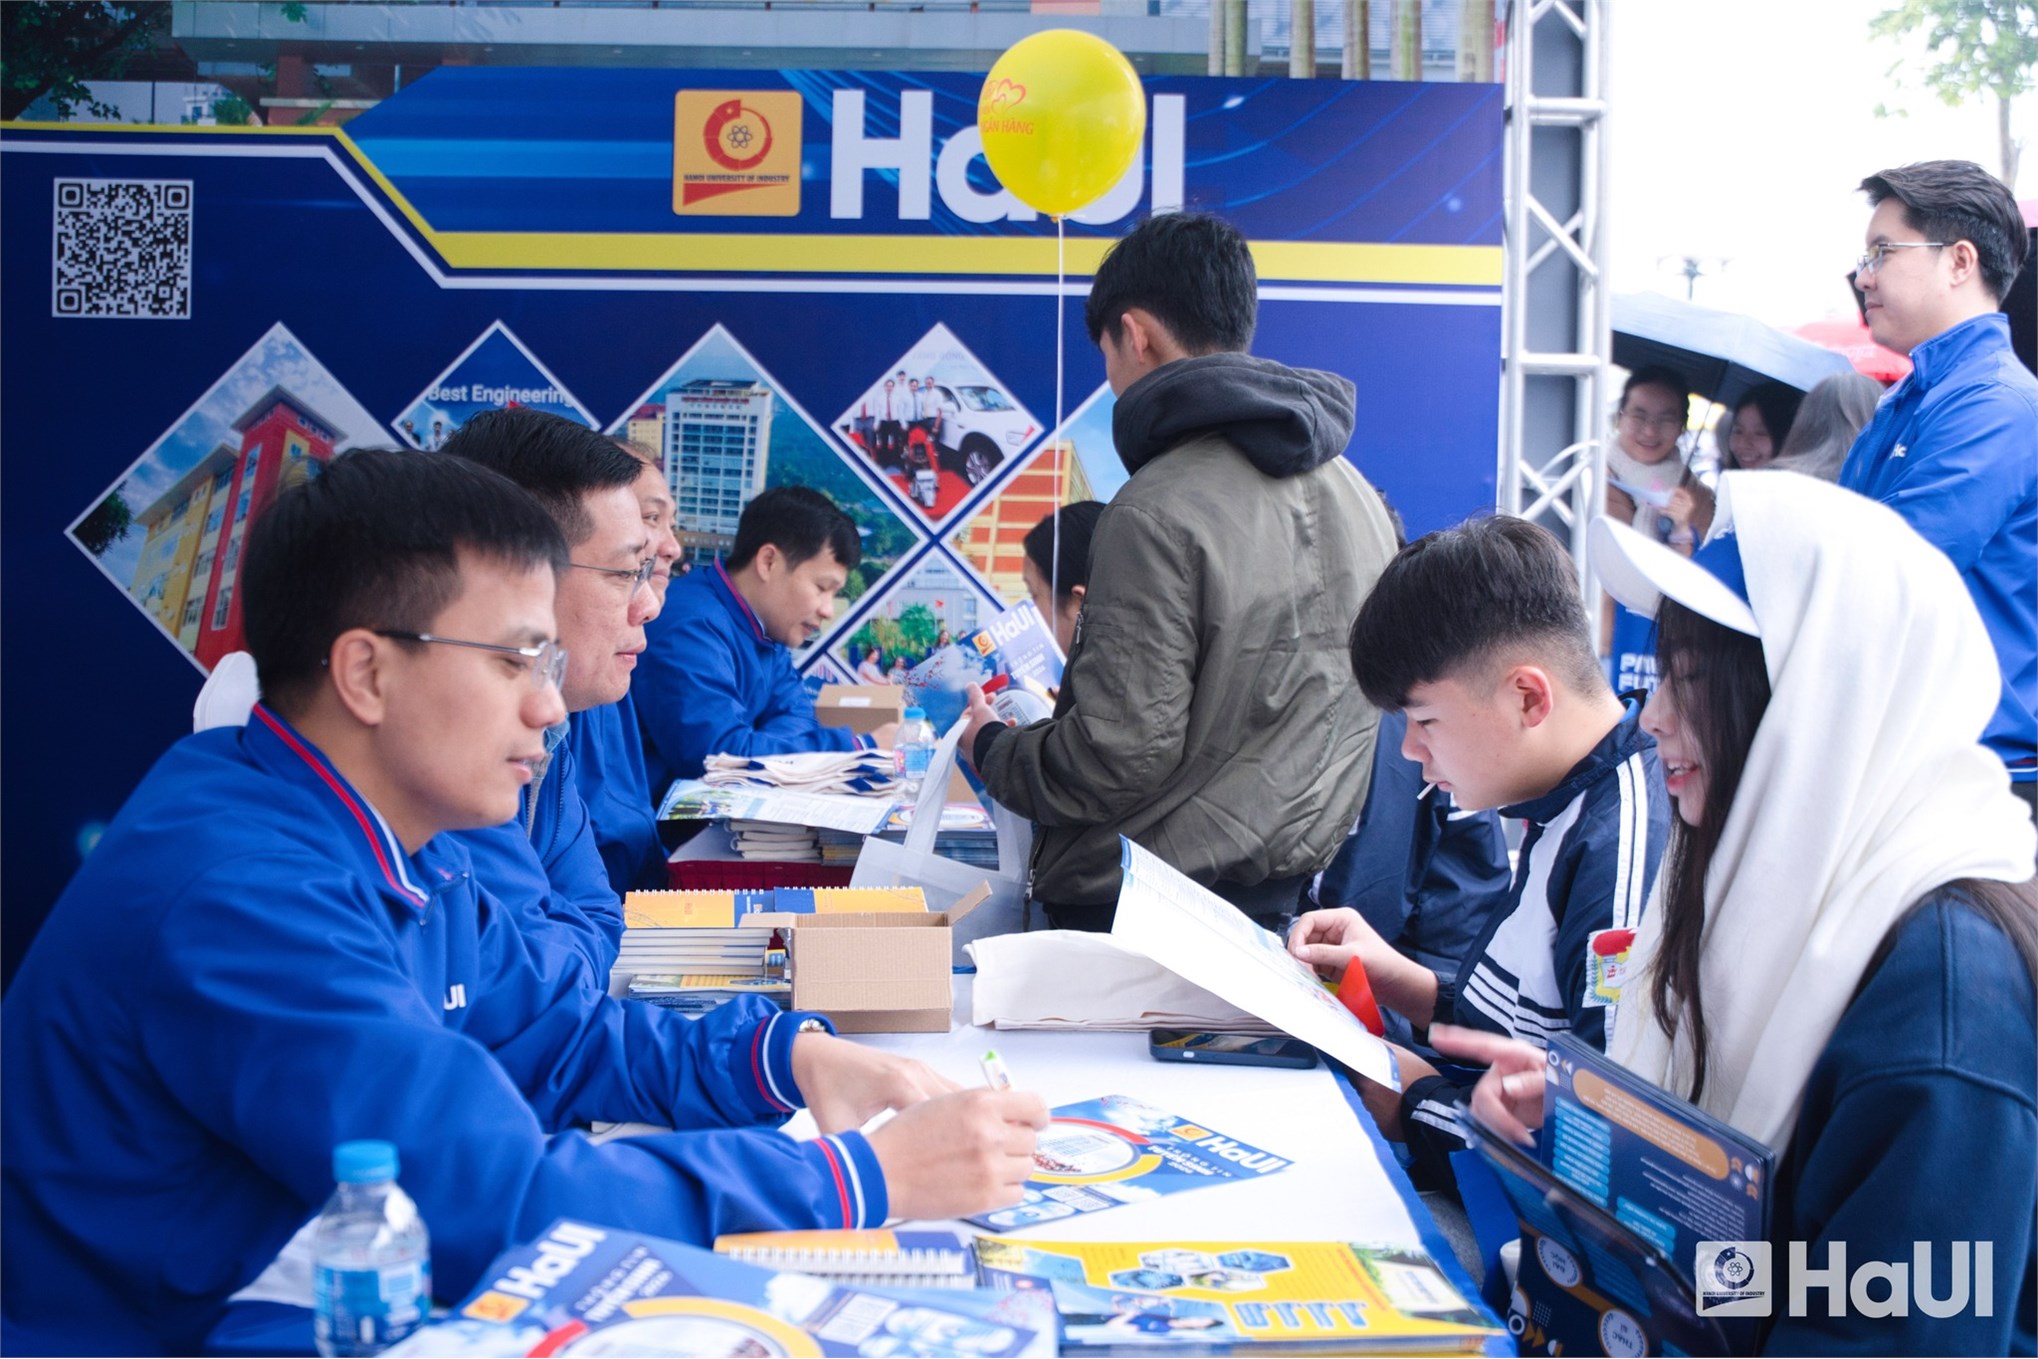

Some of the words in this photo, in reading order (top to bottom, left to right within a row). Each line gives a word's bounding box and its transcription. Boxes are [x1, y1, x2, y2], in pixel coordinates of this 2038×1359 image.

[706, 174, 745, 182] UNIVERSITY
[747, 174, 755, 182] OF
[756, 174, 790, 183] INDUSTRY
[427, 385, 468, 401] Best
[989, 605, 1036, 646] HaUI
[443, 983, 467, 1010] UI
[1195, 1136, 1288, 1174] HaUI
[493, 1221, 607, 1299] HaUI
